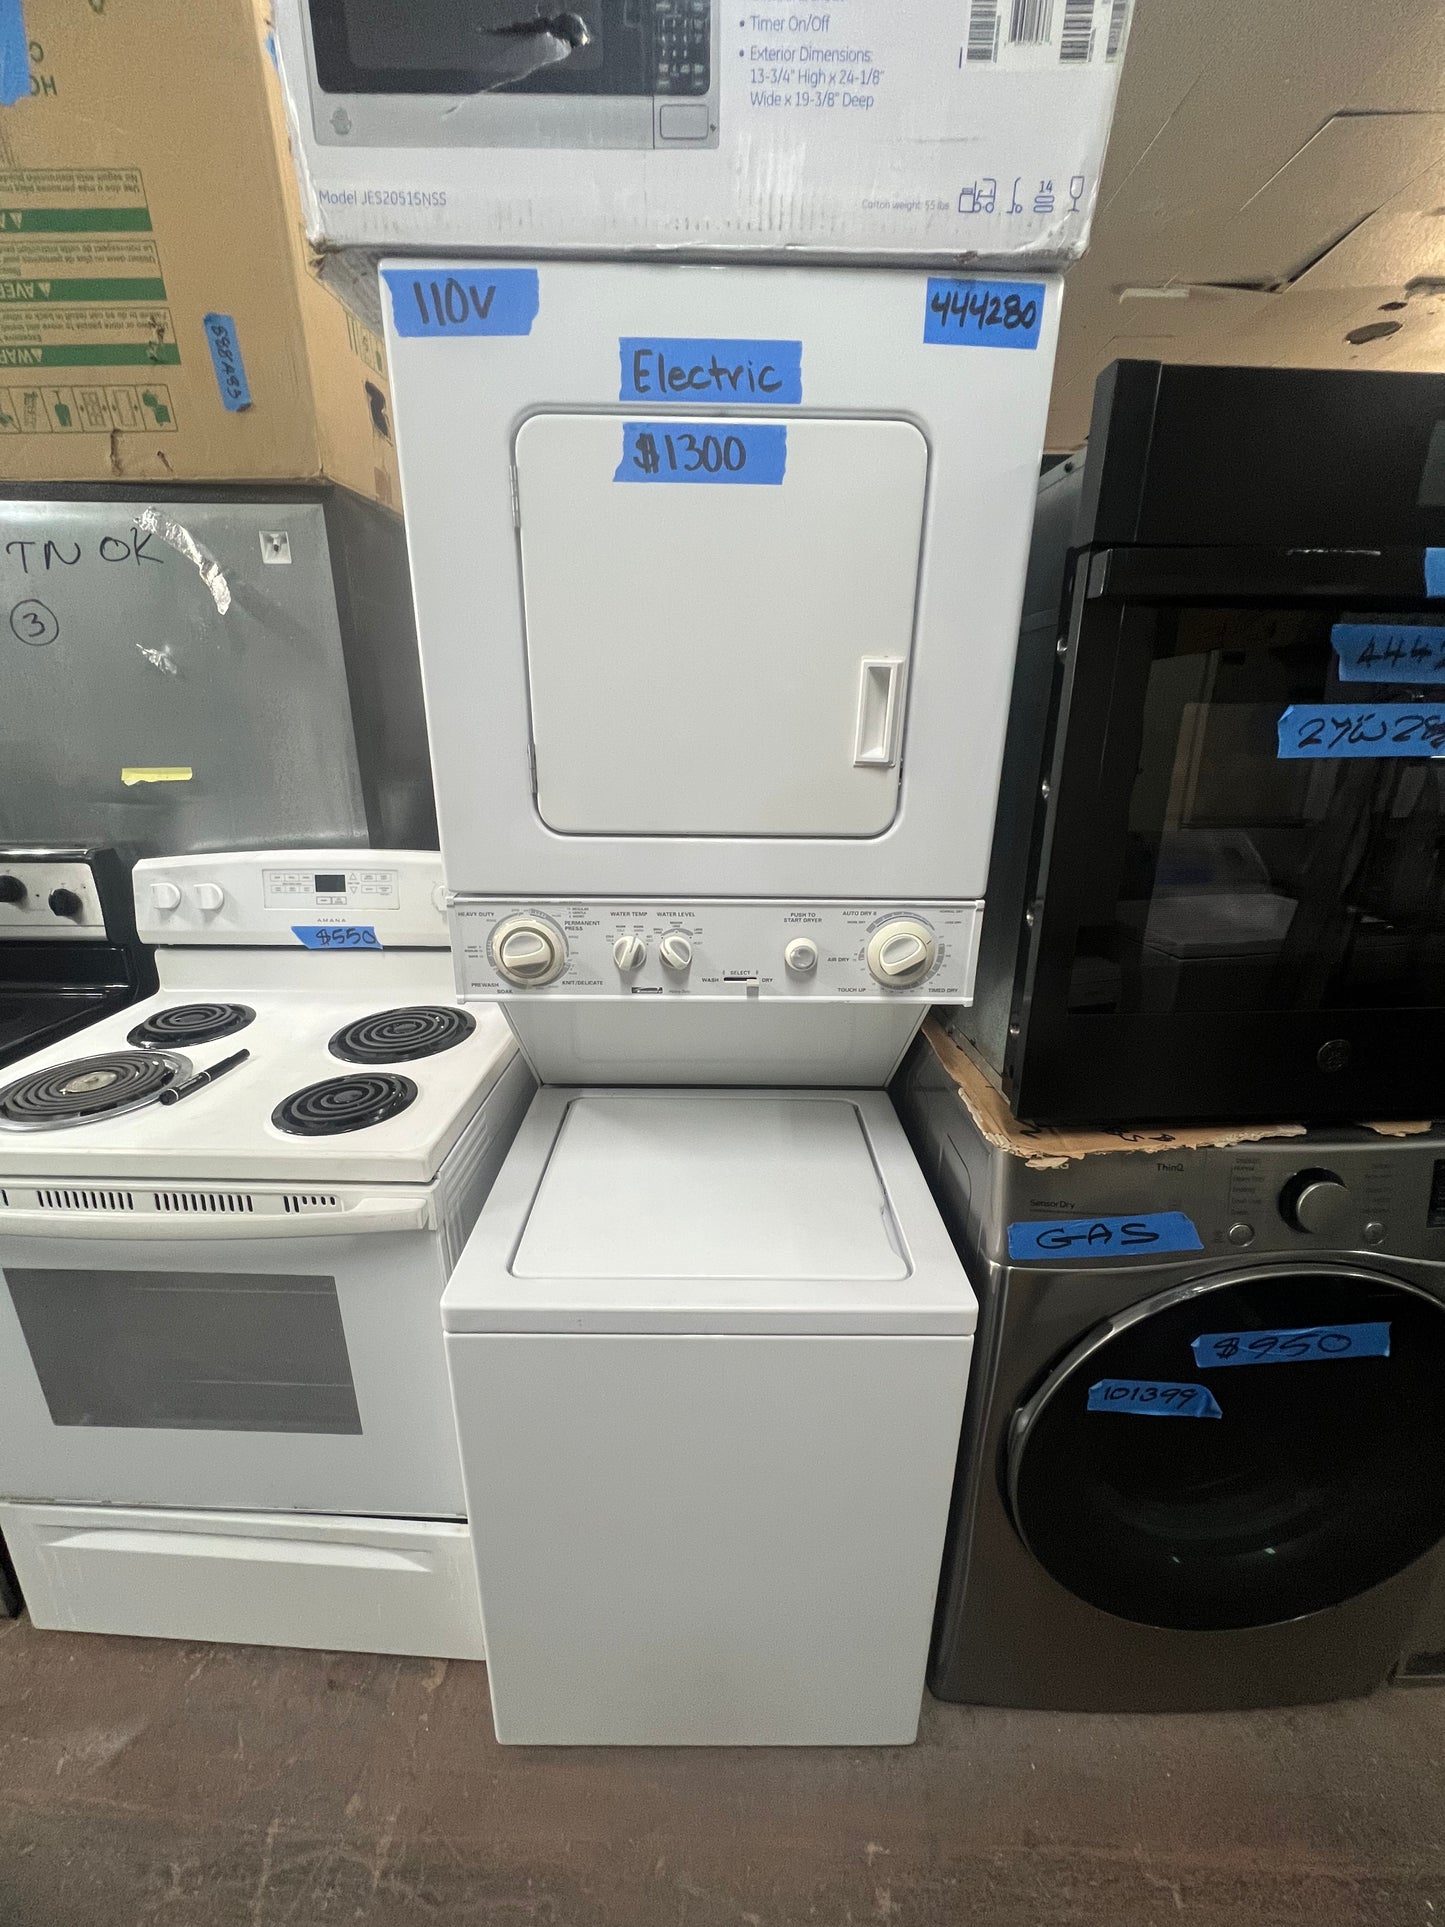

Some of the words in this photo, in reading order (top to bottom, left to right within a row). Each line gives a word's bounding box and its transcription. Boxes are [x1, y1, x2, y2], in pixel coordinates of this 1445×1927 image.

[750, 14, 785, 32] Timer
[788, 13, 831, 32] On/Off
[750, 45, 796, 62] Exterior
[798, 68, 826, 88] High
[829, 75, 837, 84] x
[750, 91, 781, 107] Wide
[784, 96, 792, 106] x
[842, 92, 874, 110] Deep
[1039, 180, 1054, 193] 14
[319, 190, 358, 205] Model
[931, 290, 1037, 332] 444280
[632, 349, 784, 395] Electric
[633, 432, 748, 475] $1300
[100, 527, 164, 566] OK
[315, 928, 378, 946] $550
[1157, 1162, 1185, 1172] ThinQ
[1036, 1222, 1160, 1250] GAS
[1213, 1332, 1353, 1360] $950
[1104, 1386, 1199, 1410] 101399
